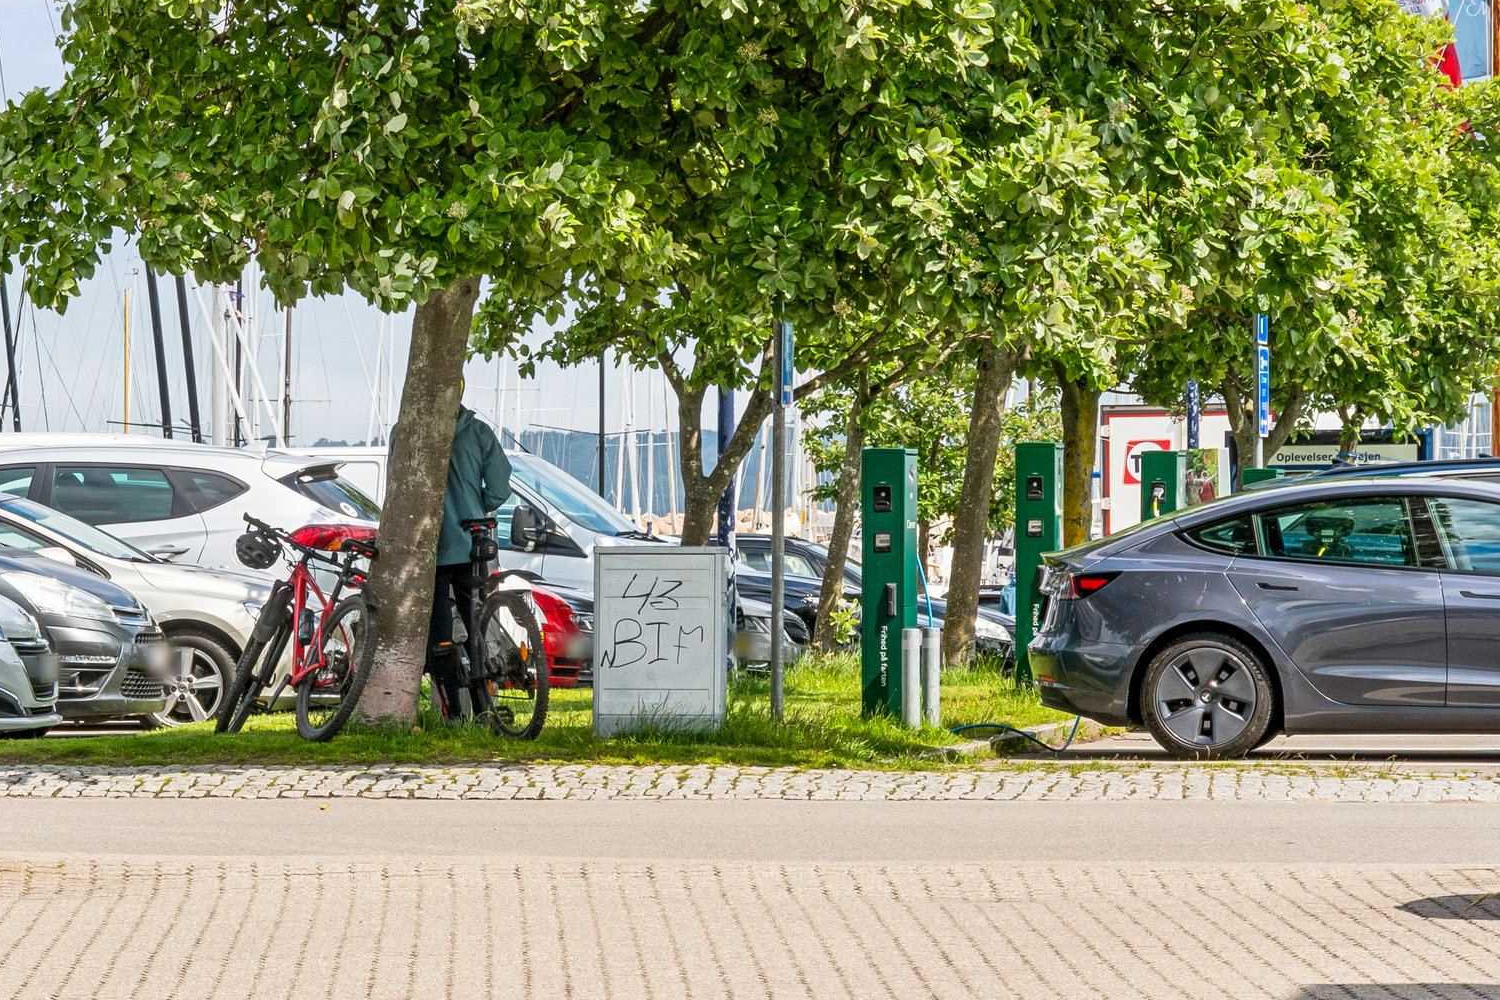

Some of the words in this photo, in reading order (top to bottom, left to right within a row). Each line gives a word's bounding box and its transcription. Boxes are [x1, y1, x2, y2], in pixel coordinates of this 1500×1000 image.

[1276, 452, 1333, 464] Oplevelser
[1355, 451, 1381, 463] ejen
[879, 651, 889, 662] på
